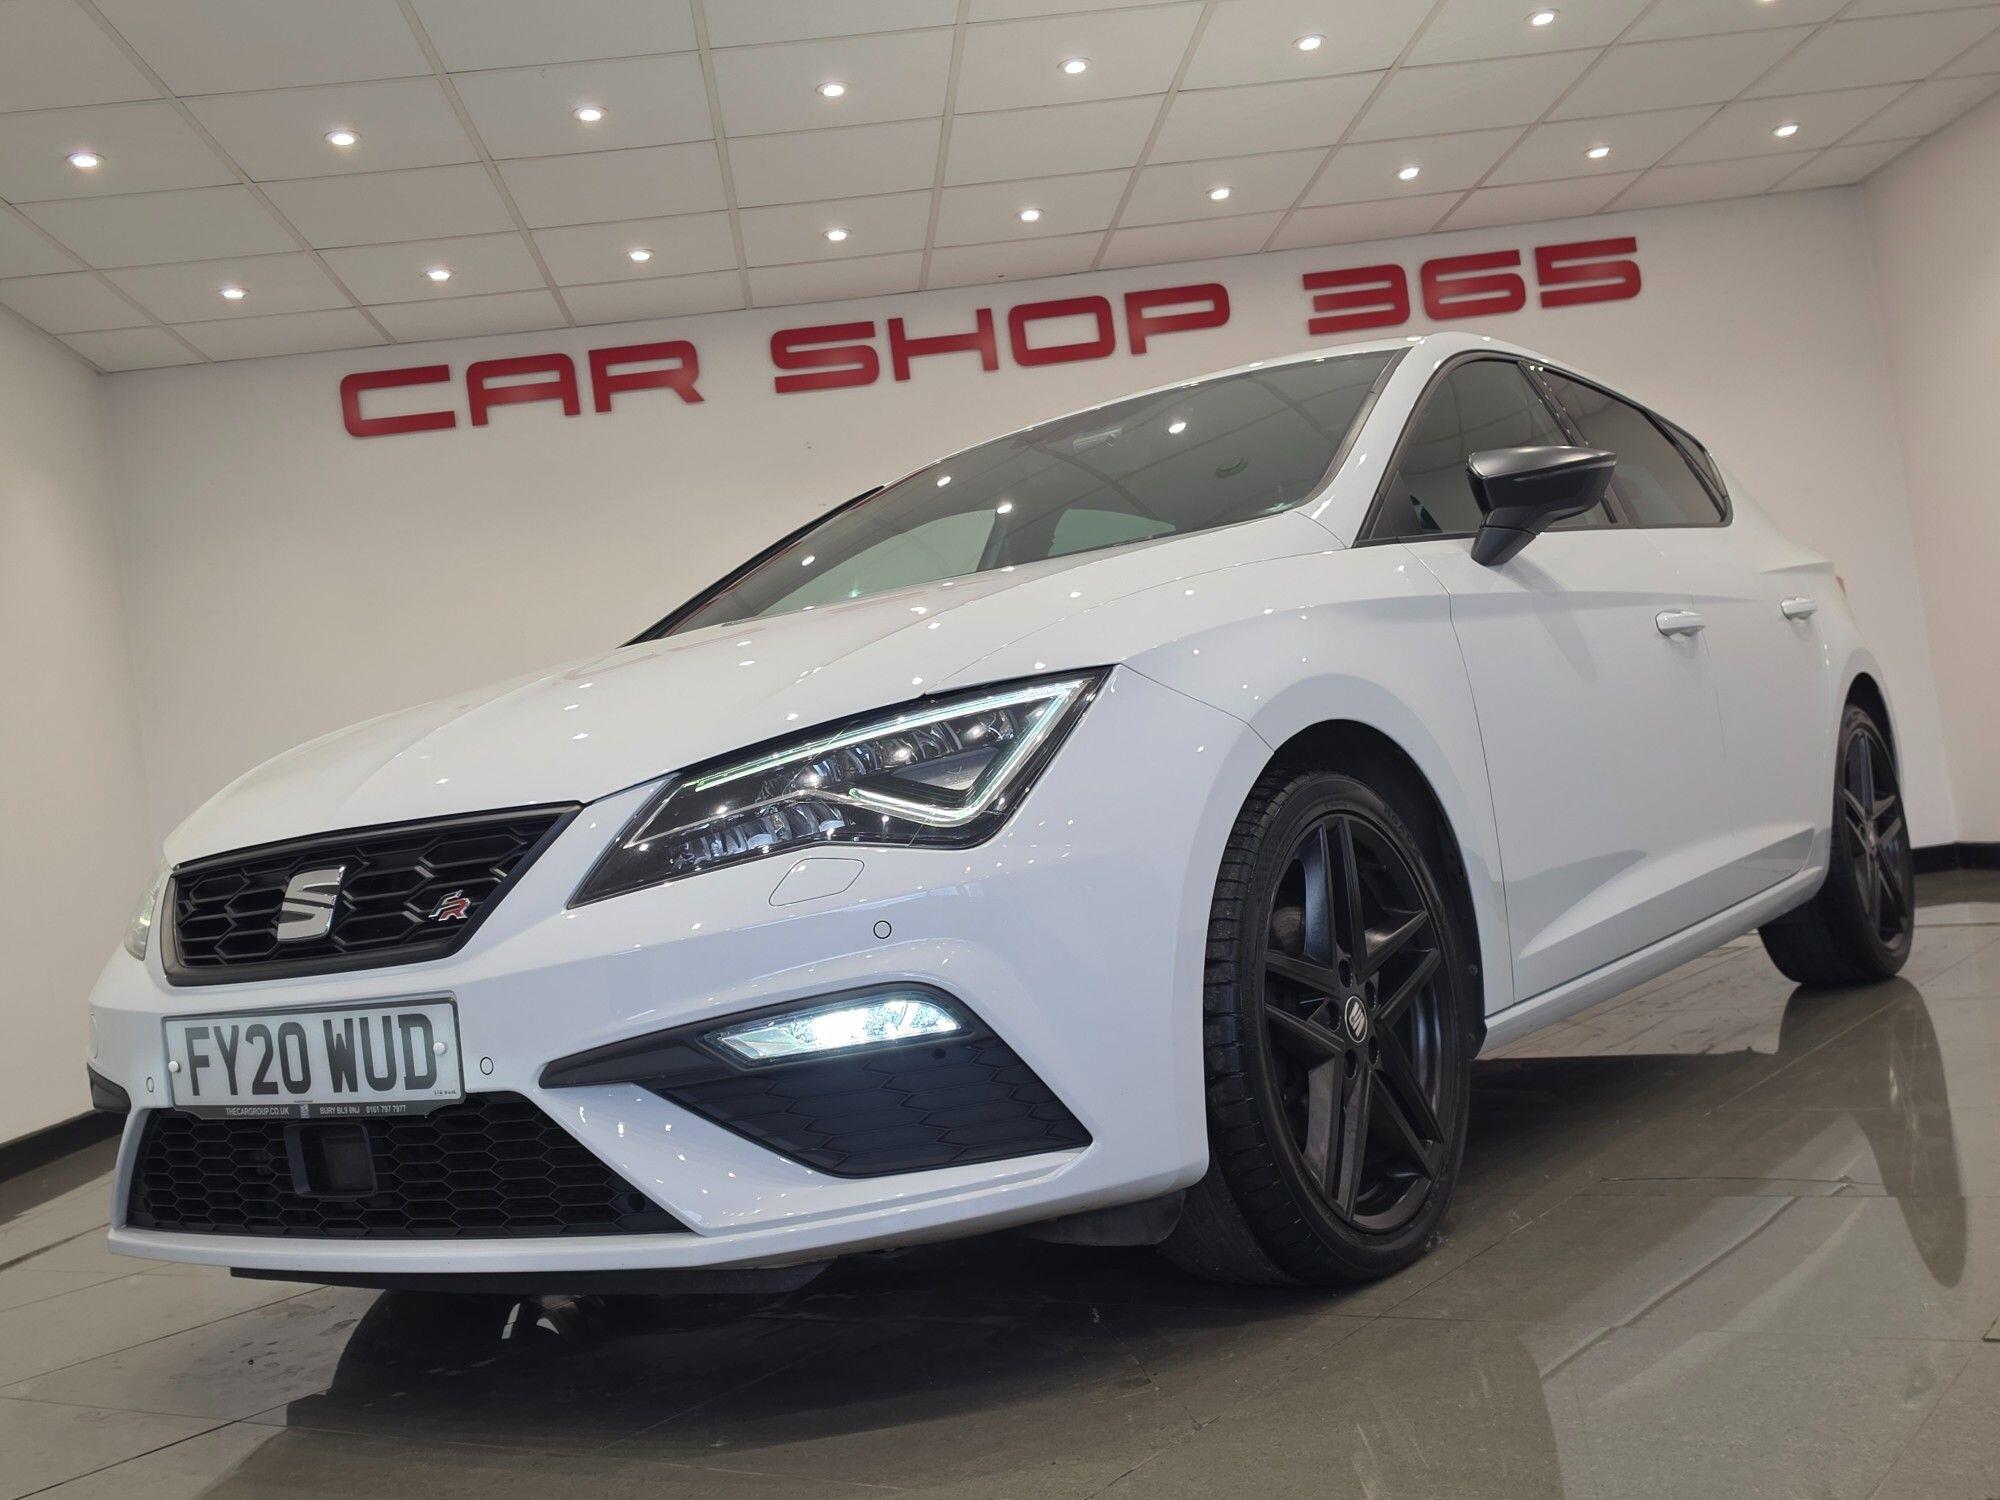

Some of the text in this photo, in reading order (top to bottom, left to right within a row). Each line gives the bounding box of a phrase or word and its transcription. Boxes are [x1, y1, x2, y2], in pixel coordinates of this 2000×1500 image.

[340, 236, 1642, 438] CAR SHOP 365
[184, 1013, 438, 1097] FY20 WUD
[319, 1105, 336, 1115] BURY
